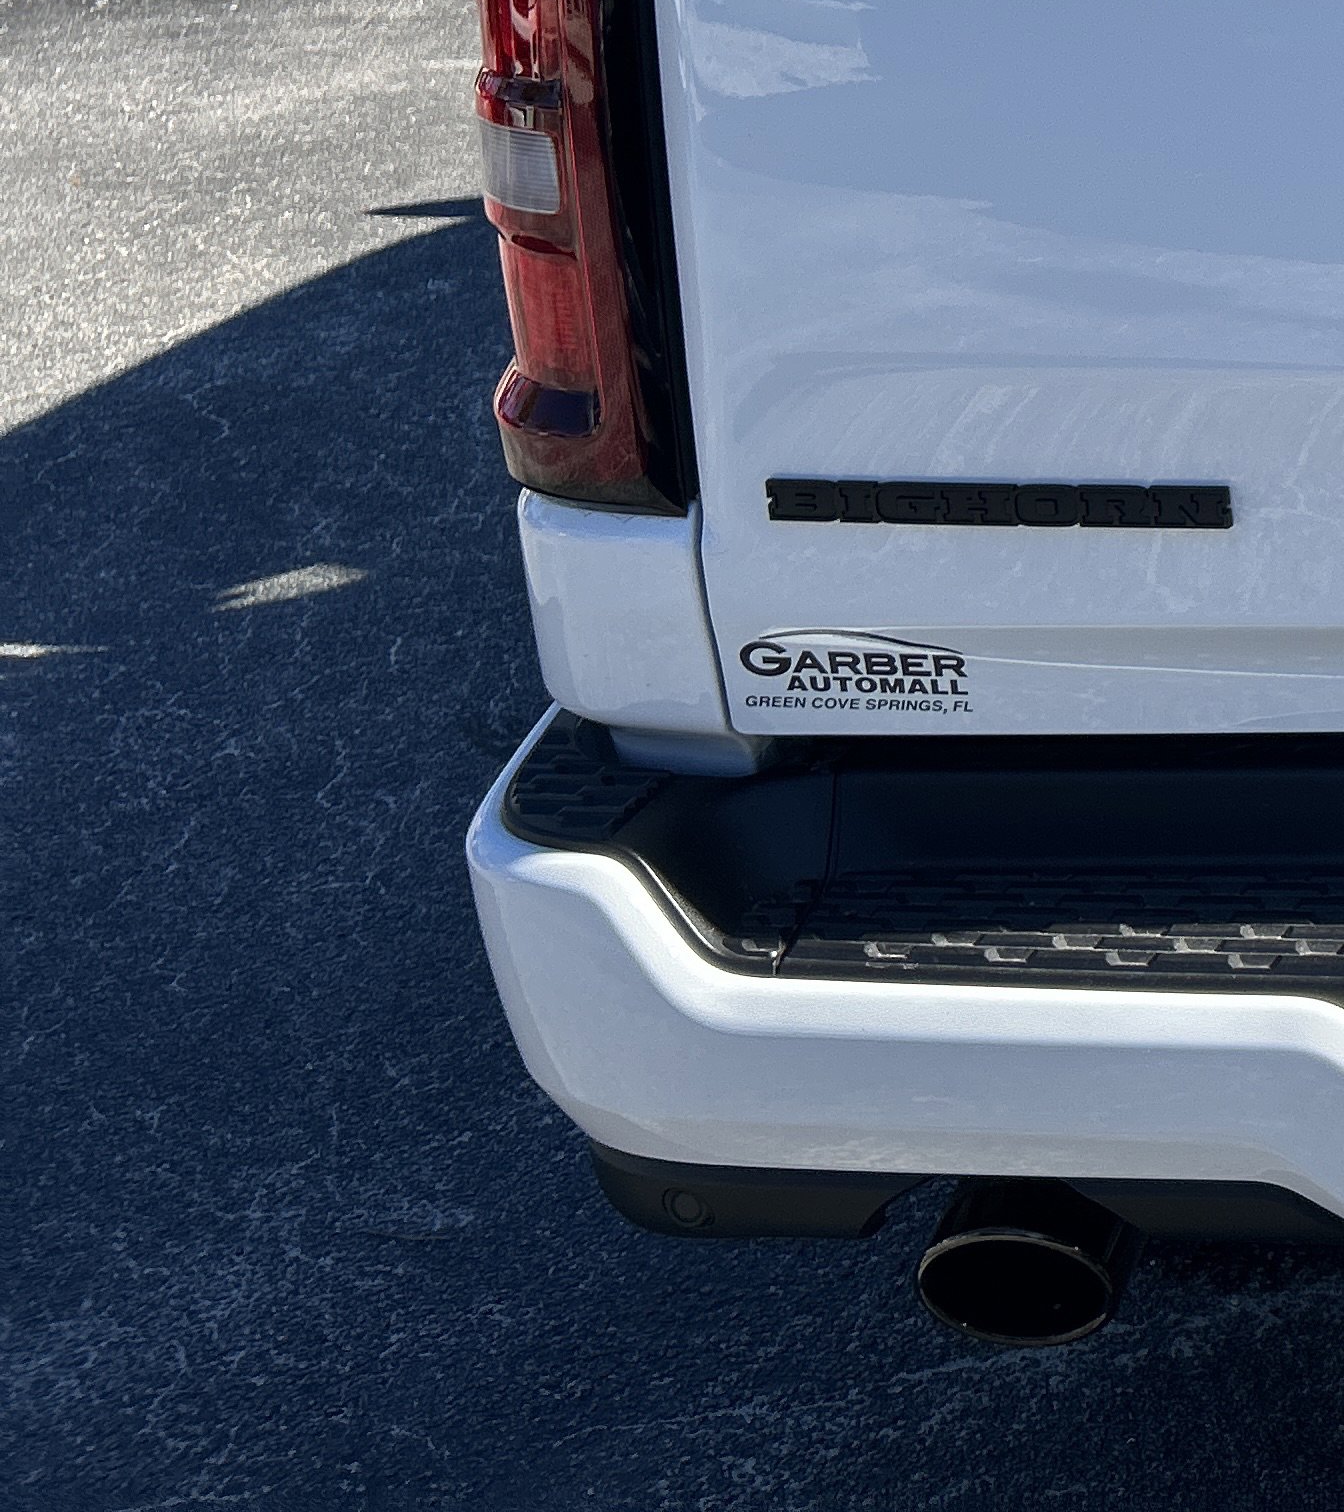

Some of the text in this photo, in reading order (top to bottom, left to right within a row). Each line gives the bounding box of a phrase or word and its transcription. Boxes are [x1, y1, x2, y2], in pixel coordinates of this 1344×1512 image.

[765, 477, 1234, 529] BIGHORN
[739, 640, 969, 678] GARBER
[787, 675, 969, 696] AUTOMALL
[745, 695, 974, 714] GREEN COVE SPRINGS, FL
